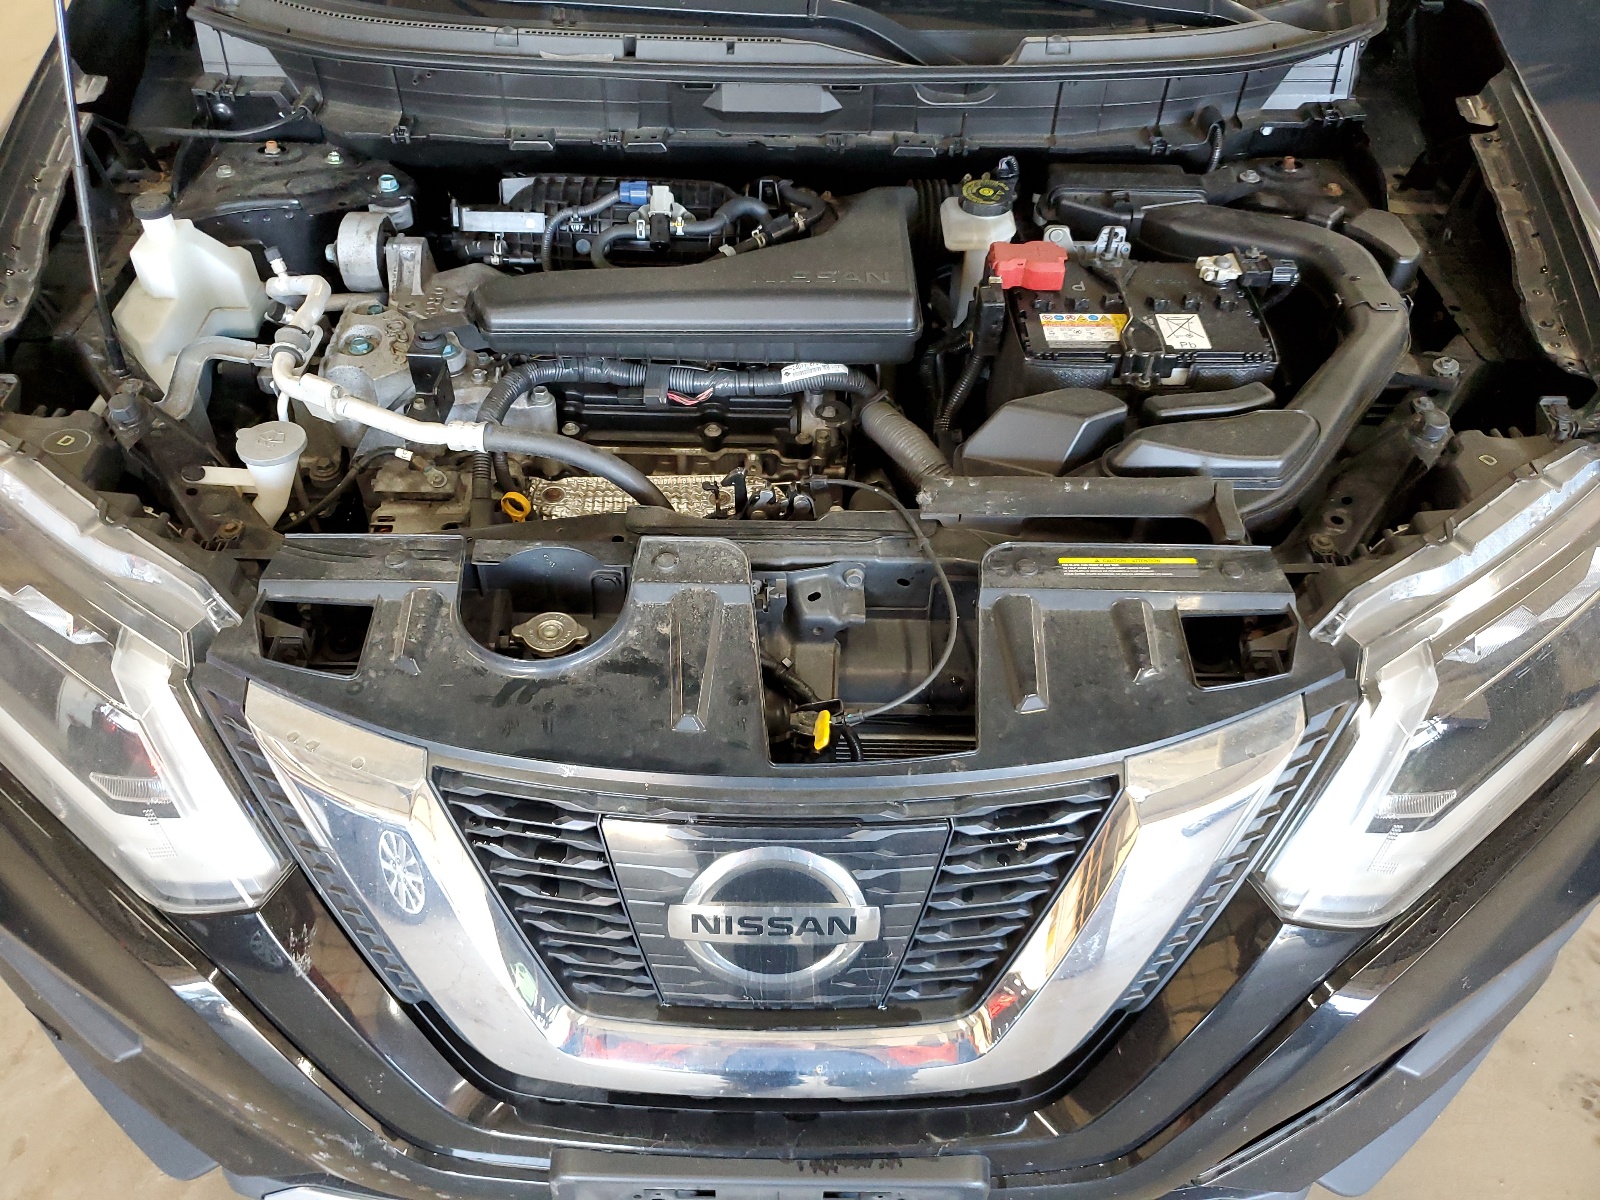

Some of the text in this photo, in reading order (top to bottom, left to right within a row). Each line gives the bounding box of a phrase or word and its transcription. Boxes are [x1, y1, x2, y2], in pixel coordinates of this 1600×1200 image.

[751, 270, 890, 283] SSAN
[1179, 341, 1198, 349] Pb
[56, 434, 76, 446] D
[691, 913, 857, 936] NISSAN
